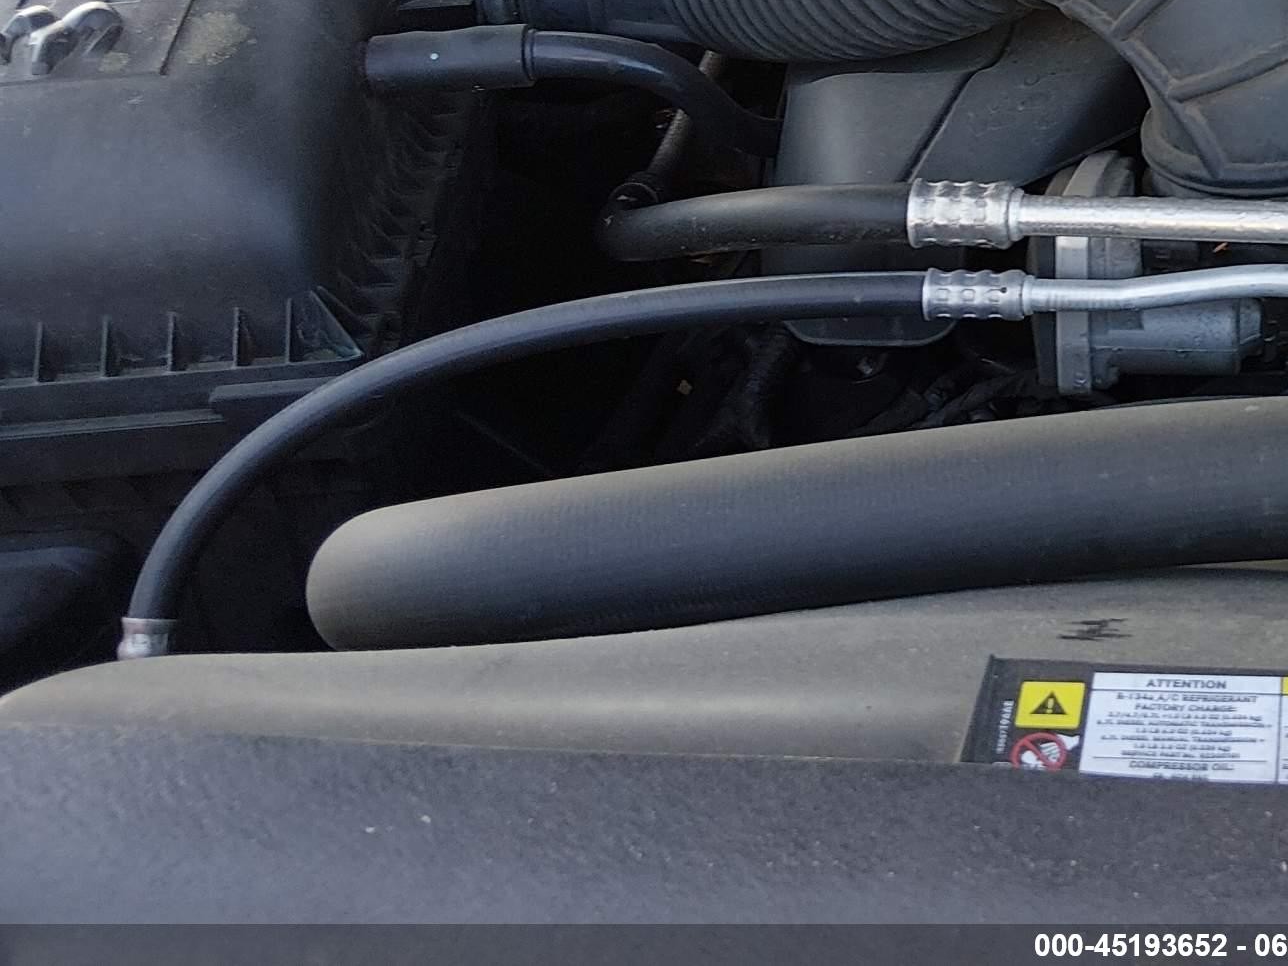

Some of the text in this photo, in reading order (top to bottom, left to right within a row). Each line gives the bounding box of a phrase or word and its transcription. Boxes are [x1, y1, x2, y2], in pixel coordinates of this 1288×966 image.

[1146, 678, 1227, 690] ATTENTION
[1134, 703, 1184, 713] FACTORY
[1129, 760, 1209, 772] COMPRESSOR
